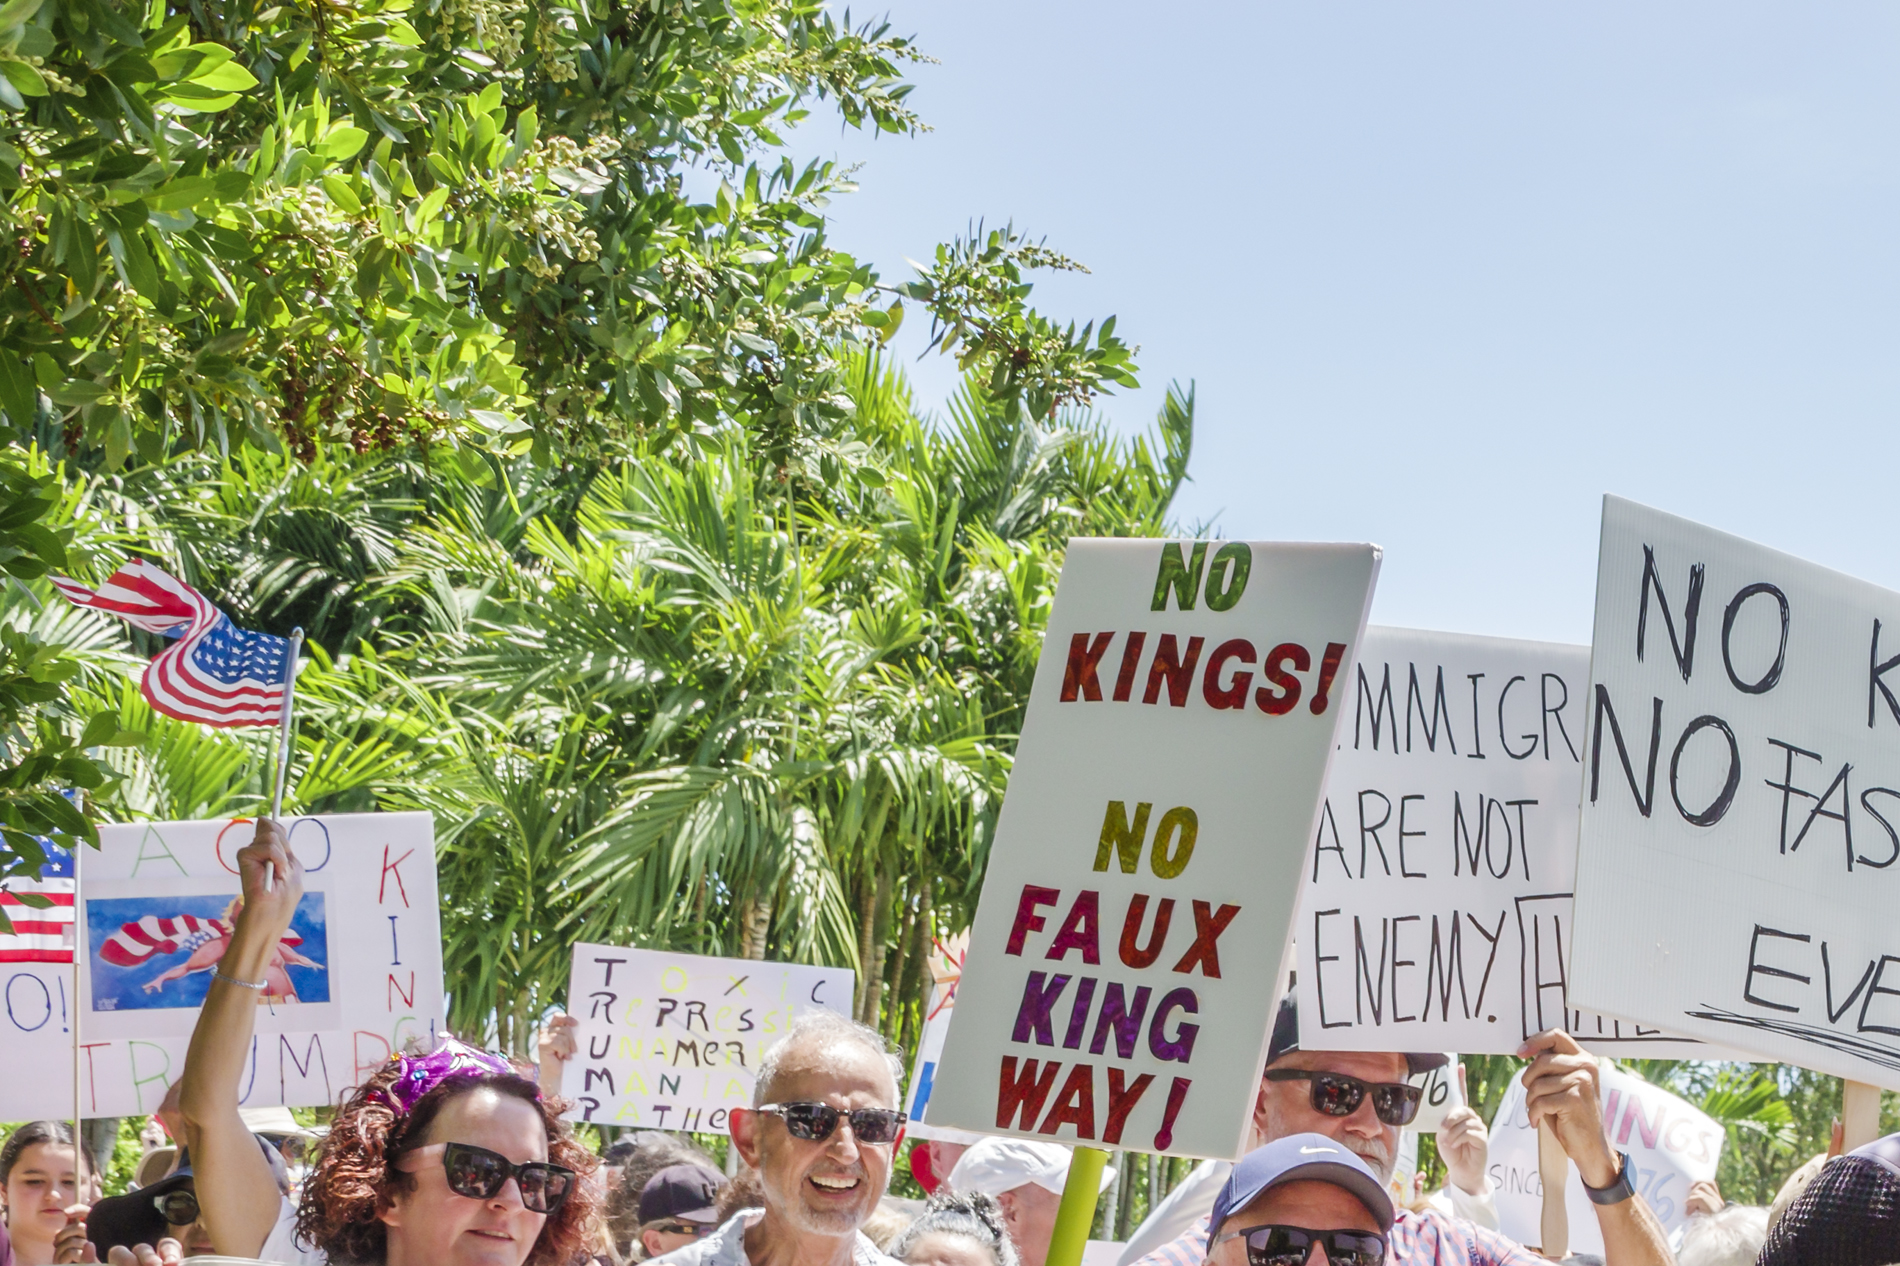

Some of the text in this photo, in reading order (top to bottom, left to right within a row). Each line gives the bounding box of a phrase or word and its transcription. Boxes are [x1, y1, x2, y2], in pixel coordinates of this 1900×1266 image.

[1150, 541, 1252, 612] NO
[1636, 543, 1790, 694] NO
[1059, 630, 1348, 717] KINGS!
[1338, 661, 1586, 763] MMIGR
[1590, 683, 1741, 827] NO
[1093, 800, 1199, 880] NO
[1313, 789, 1539, 882] ARE NOT
[1005, 883, 1242, 980] FAUX
[1315, 908, 1507, 1029] ENEMY.
[1011, 970, 1200, 1064] KING
[995, 1055, 1193, 1152] WAY!
[1603, 1088, 1712, 1164] INGS
